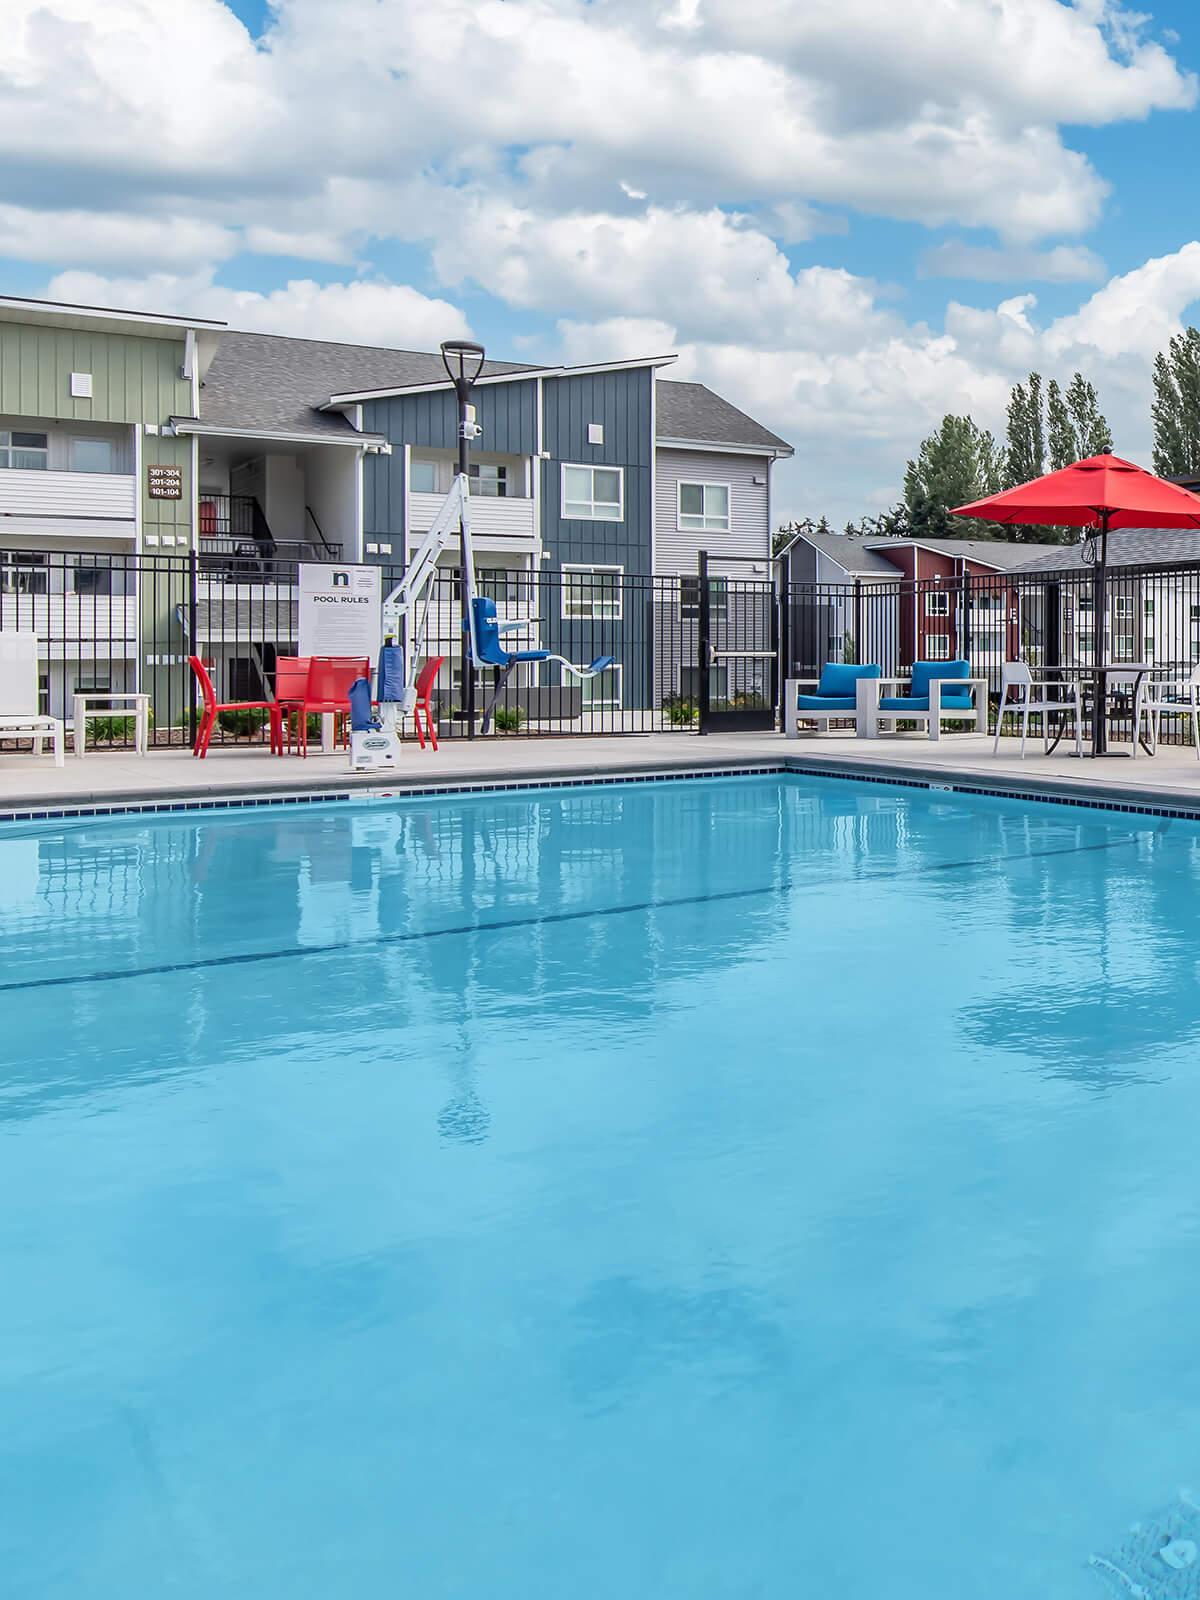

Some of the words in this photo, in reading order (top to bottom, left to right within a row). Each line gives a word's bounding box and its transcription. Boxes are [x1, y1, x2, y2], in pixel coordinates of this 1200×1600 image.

[150, 469, 180, 477] 301-304
[150, 478, 180, 486] 201-204
[333, 572, 349, 586] n
